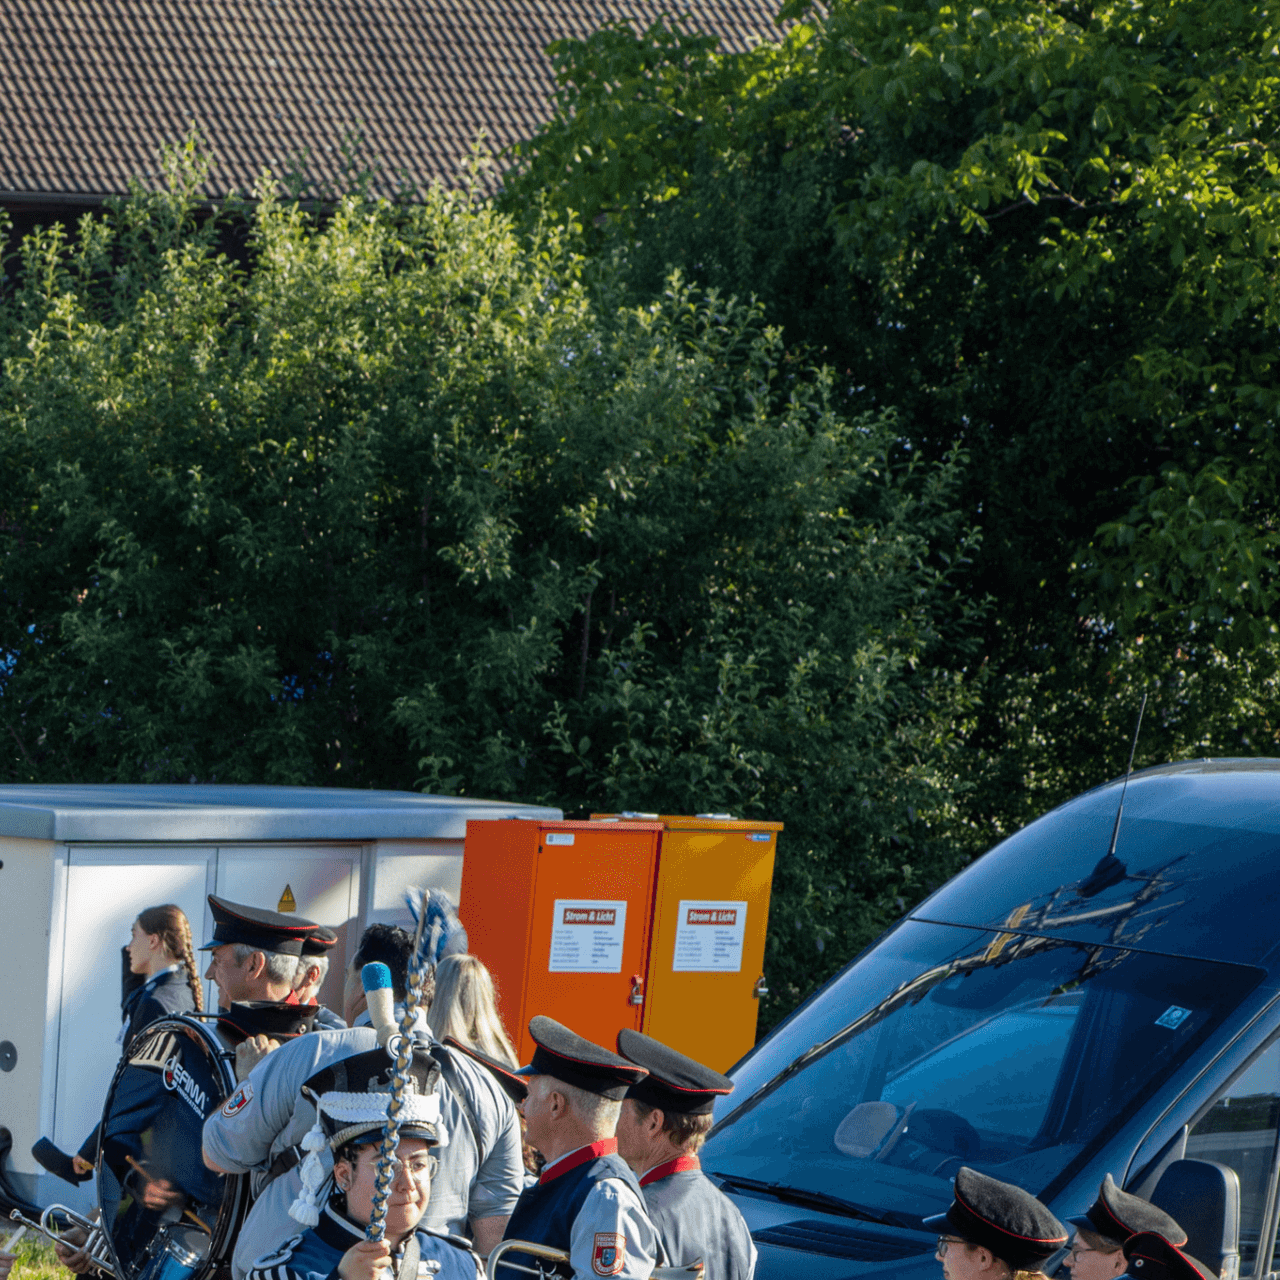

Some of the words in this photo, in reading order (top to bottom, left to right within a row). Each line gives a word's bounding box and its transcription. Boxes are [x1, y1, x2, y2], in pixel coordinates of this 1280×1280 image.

[565, 910, 588, 922] Strom
[589, 910, 596, 922] &
[596, 911, 614, 922] Licht
[689, 910, 711, 922] Strom
[712, 910, 718, 922] &
[718, 910, 735, 922] Licht
